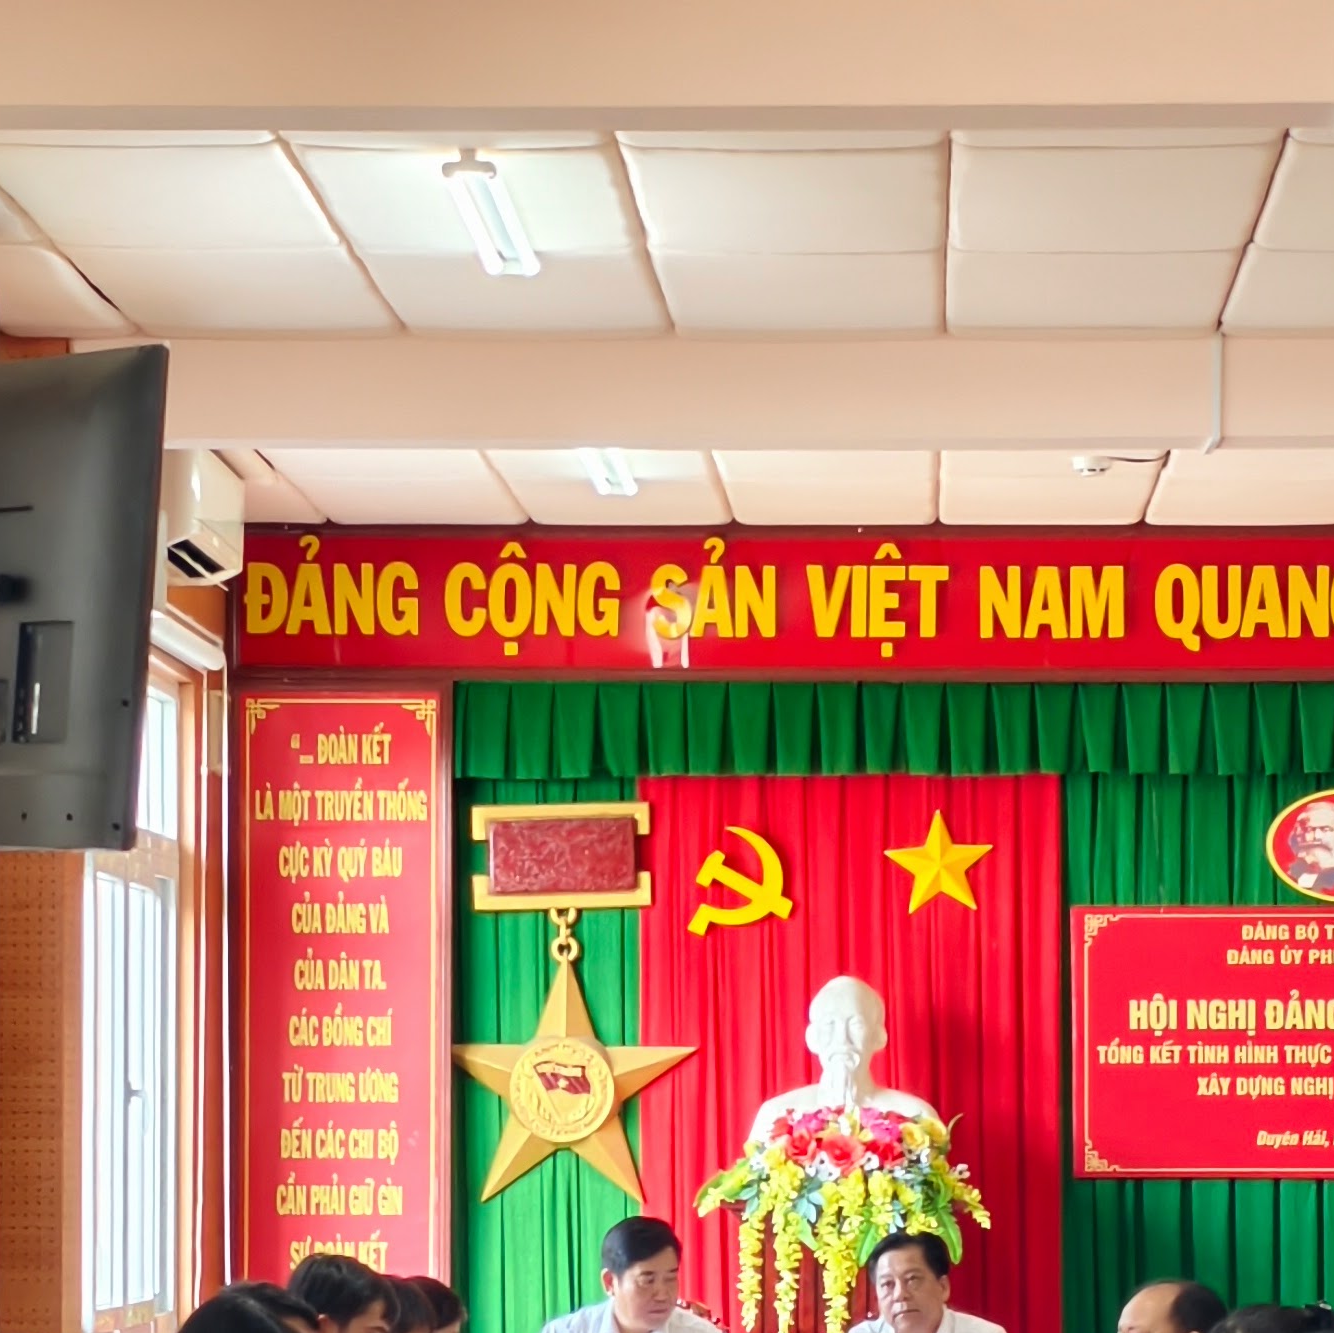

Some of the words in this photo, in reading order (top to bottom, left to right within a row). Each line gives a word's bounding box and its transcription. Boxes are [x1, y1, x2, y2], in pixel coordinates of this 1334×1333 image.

[245, 537, 419, 636] ĐẢNG
[444, 542, 621, 656] CỘNG
[650, 537, 777, 639] SẢN
[806, 543, 950, 658] VIỆT
[979, 566, 1125, 640] NAM
[317, 726, 358, 765] ĐOÀN
[361, 722, 392, 765] KẾT
[255, 781, 274, 820] LÀ
[278, 782, 312, 827] MỘT
[376, 777, 428, 823] THỐNG
[279, 841, 310, 883] CỰC
[312, 838, 334, 878] KỲ
[336, 837, 368, 884] QUÝ
[370, 837, 404, 879] BÁU
[291, 891, 323, 934] CỦA
[324, 890, 367, 935] ĐẢNG
[368, 894, 390, 935] VÀ
[1241, 920, 1290, 941] ĐẢNG
[1294, 921, 1320, 944] BỘ
[294, 948, 326, 991] CỦA
[328, 951, 360, 991] DÂN
[361, 958, 388, 992] TA.
[1226, 945, 1275, 965] ĐẢNG
[1280, 944, 1304, 965] ỦY
[288, 1007, 319, 1047] CÁC
[366, 1007, 393, 1046] CHÍ
[1128, 992, 1178, 1037] HỘI
[1186, 998, 1257, 1037] NGHỊ
[1149, 1039, 1183, 1065] KẾT
[1186, 1040, 1230, 1065] TÌNH
[1234, 1040, 1279, 1064] HÌNH
[1283, 1043, 1332, 1068] THỰC
[282, 1064, 304, 1103] TỪ
[306, 1071, 355, 1103] TRUNG
[358, 1065, 399, 1103] ƯƠNG
[1196, 1072, 1232, 1096] XÂY
[1235, 1074, 1286, 1100] DỰNG
[1290, 1076, 1334, 1100] NGHỊ
[280, 1116, 313, 1159] ĐẾN
[315, 1119, 345, 1159] CÁC
[348, 1128, 374, 1159] CHI
[377, 1120, 399, 1166] BỘ
[1256, 1130, 1300, 1149] Duyên
[309, 1172, 346, 1216] PHẢI
[348, 1177, 375, 1216] GIỮ
[377, 1177, 403, 1216] GÌN
[357, 1228, 388, 1274] KẾT
